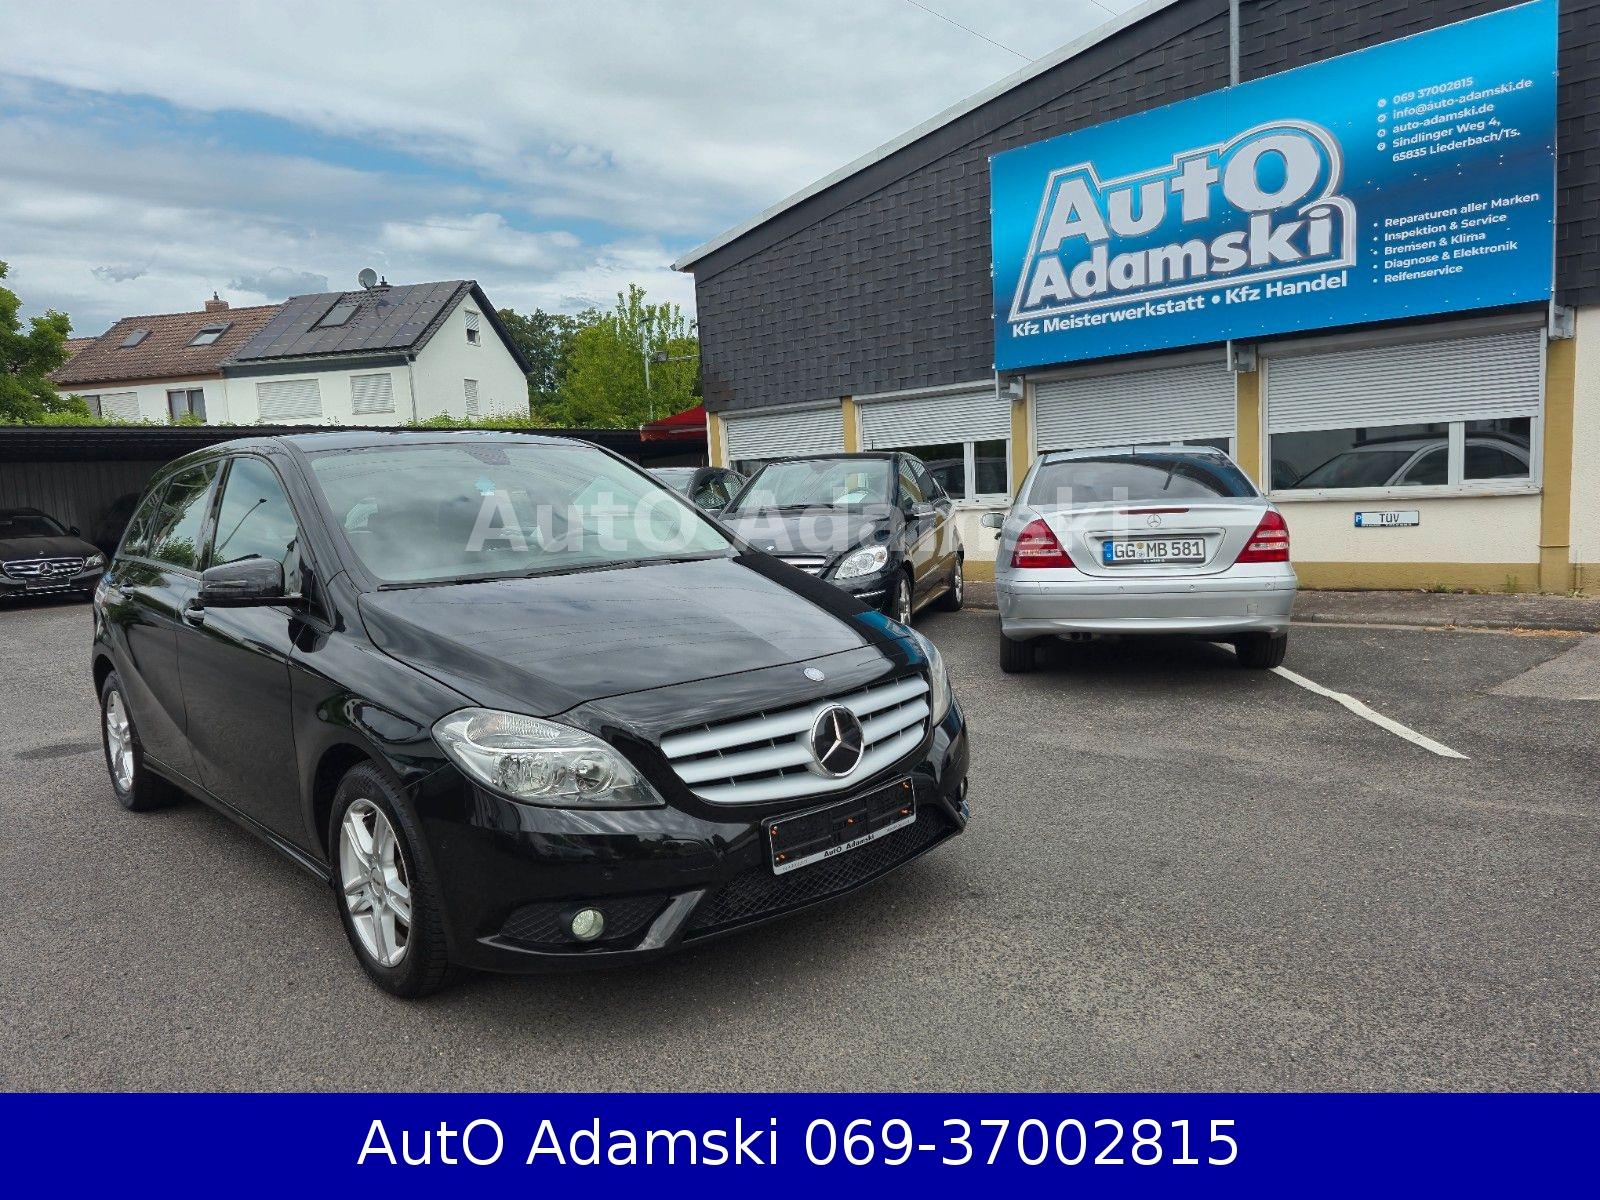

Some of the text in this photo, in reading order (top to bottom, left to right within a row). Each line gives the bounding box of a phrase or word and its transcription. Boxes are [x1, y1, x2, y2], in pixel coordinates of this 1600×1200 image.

[1393, 76, 1473, 104] 069 37002815
[1393, 78, 1533, 119] info@auto-adamski.de
[1393, 103, 1494, 134] auto-adamski.de
[1393, 116, 1500, 148] Sindlinger Weg 4,
[1393, 127, 1521, 162] 65835 Liederbach/Ts.
[1039, 134, 1321, 253] AutO
[1384, 193, 1539, 228] Reparaturen aller Marken
[1384, 213, 1507, 242] Inspektion & Service
[1025, 207, 1332, 307] Adamski
[1384, 231, 1486, 255] Bremsen & Klima
[1384, 241, 1518, 269] Diagnose & Elektronik
[1384, 264, 1464, 283] Reifenservice
[1012, 270, 1348, 338] Kfz Meisterwerkstatt Kfz Handel
[1379, 513, 1400, 523] TÜV
[1114, 541, 1202, 558] GG MB 581
[823, 834, 875, 857] AutO Adamski
